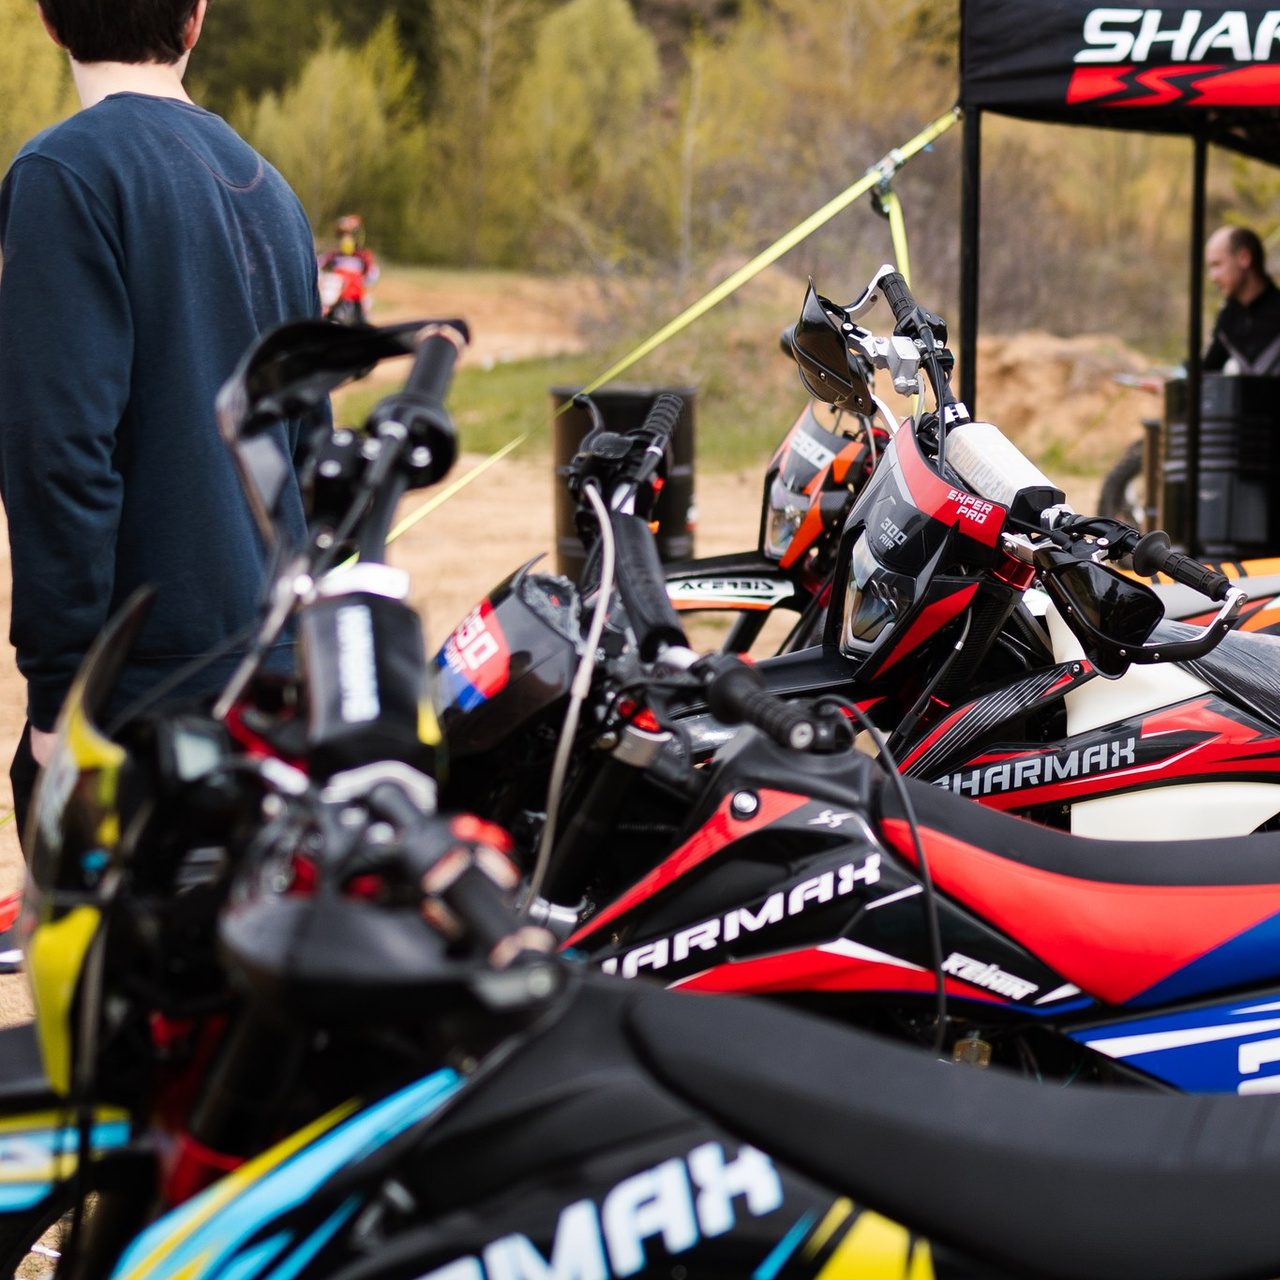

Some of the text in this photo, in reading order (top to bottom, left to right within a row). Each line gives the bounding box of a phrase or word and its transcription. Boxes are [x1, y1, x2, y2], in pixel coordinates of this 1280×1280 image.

[956, 505, 988, 525] PRO
[878, 533, 896, 550] AIR
[880, 517, 908, 546] 300
